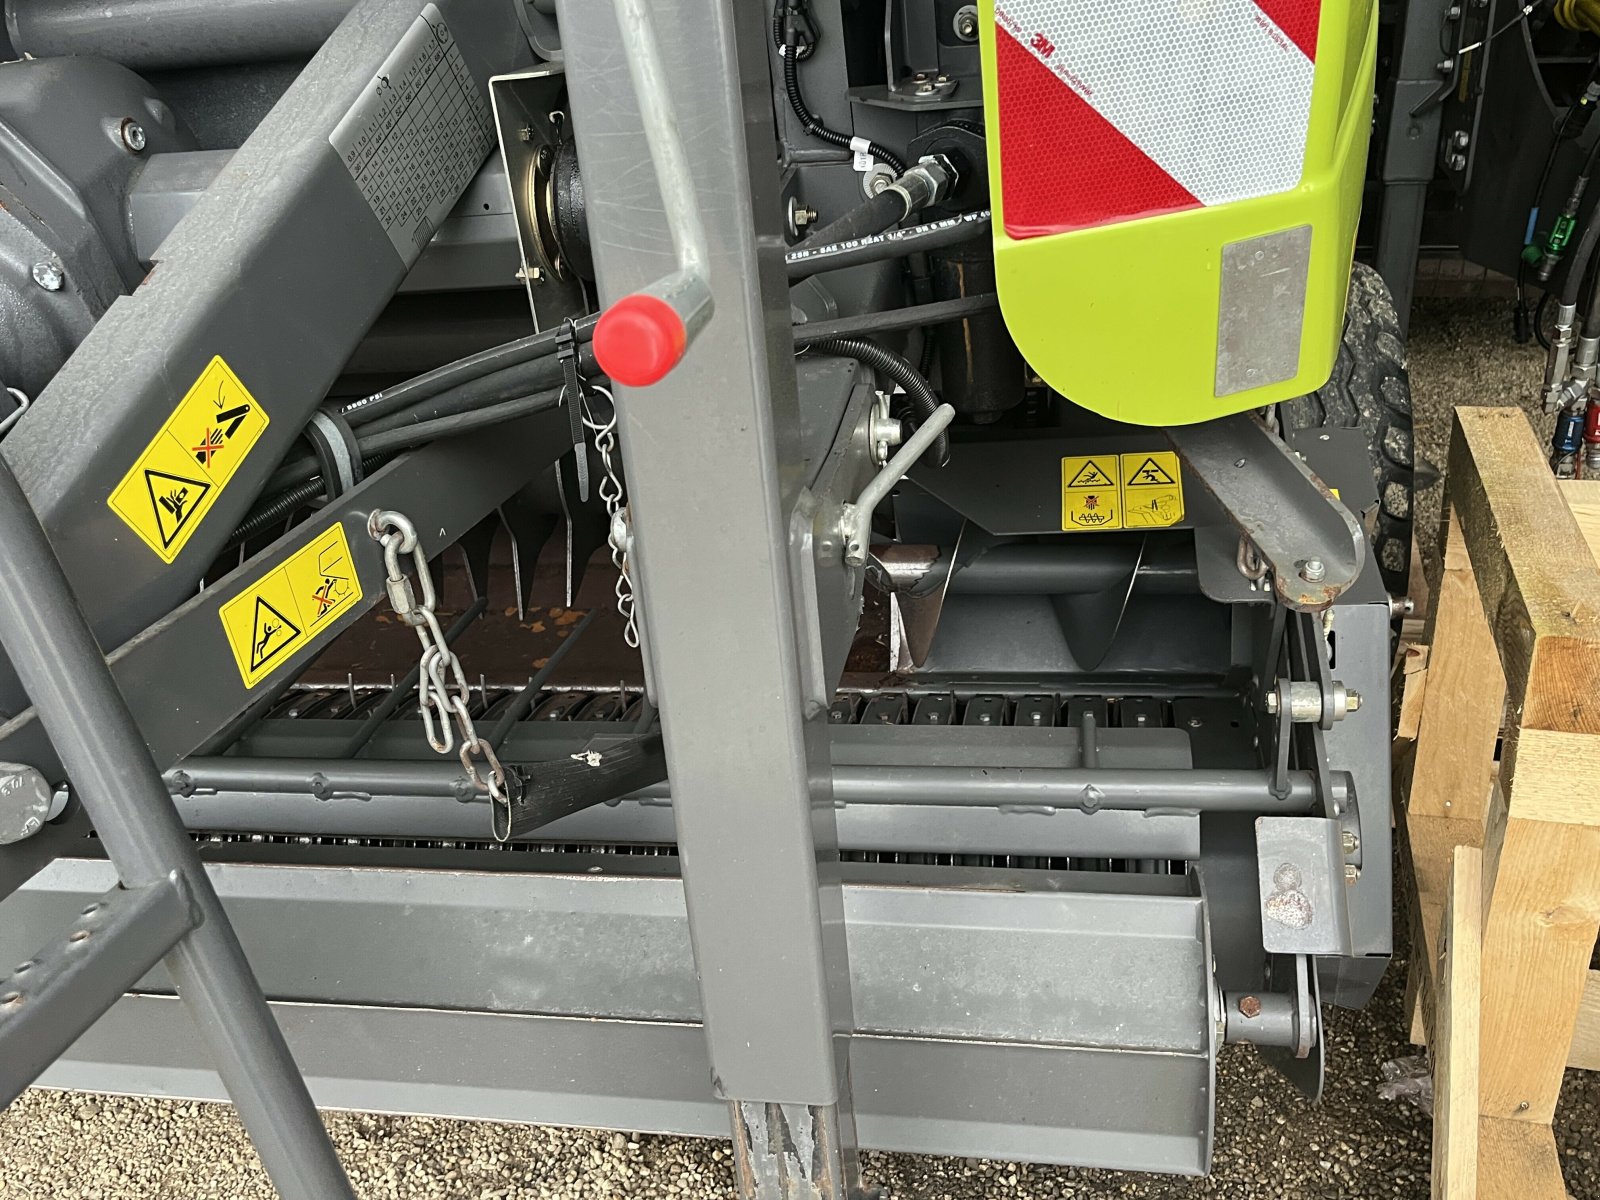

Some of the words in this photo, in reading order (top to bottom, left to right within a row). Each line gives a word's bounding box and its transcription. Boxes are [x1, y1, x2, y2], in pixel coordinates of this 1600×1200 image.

[1030, 33, 1055, 58] 3M
[840, 240, 858, 250] 100
[369, 393, 383, 402] PSI
